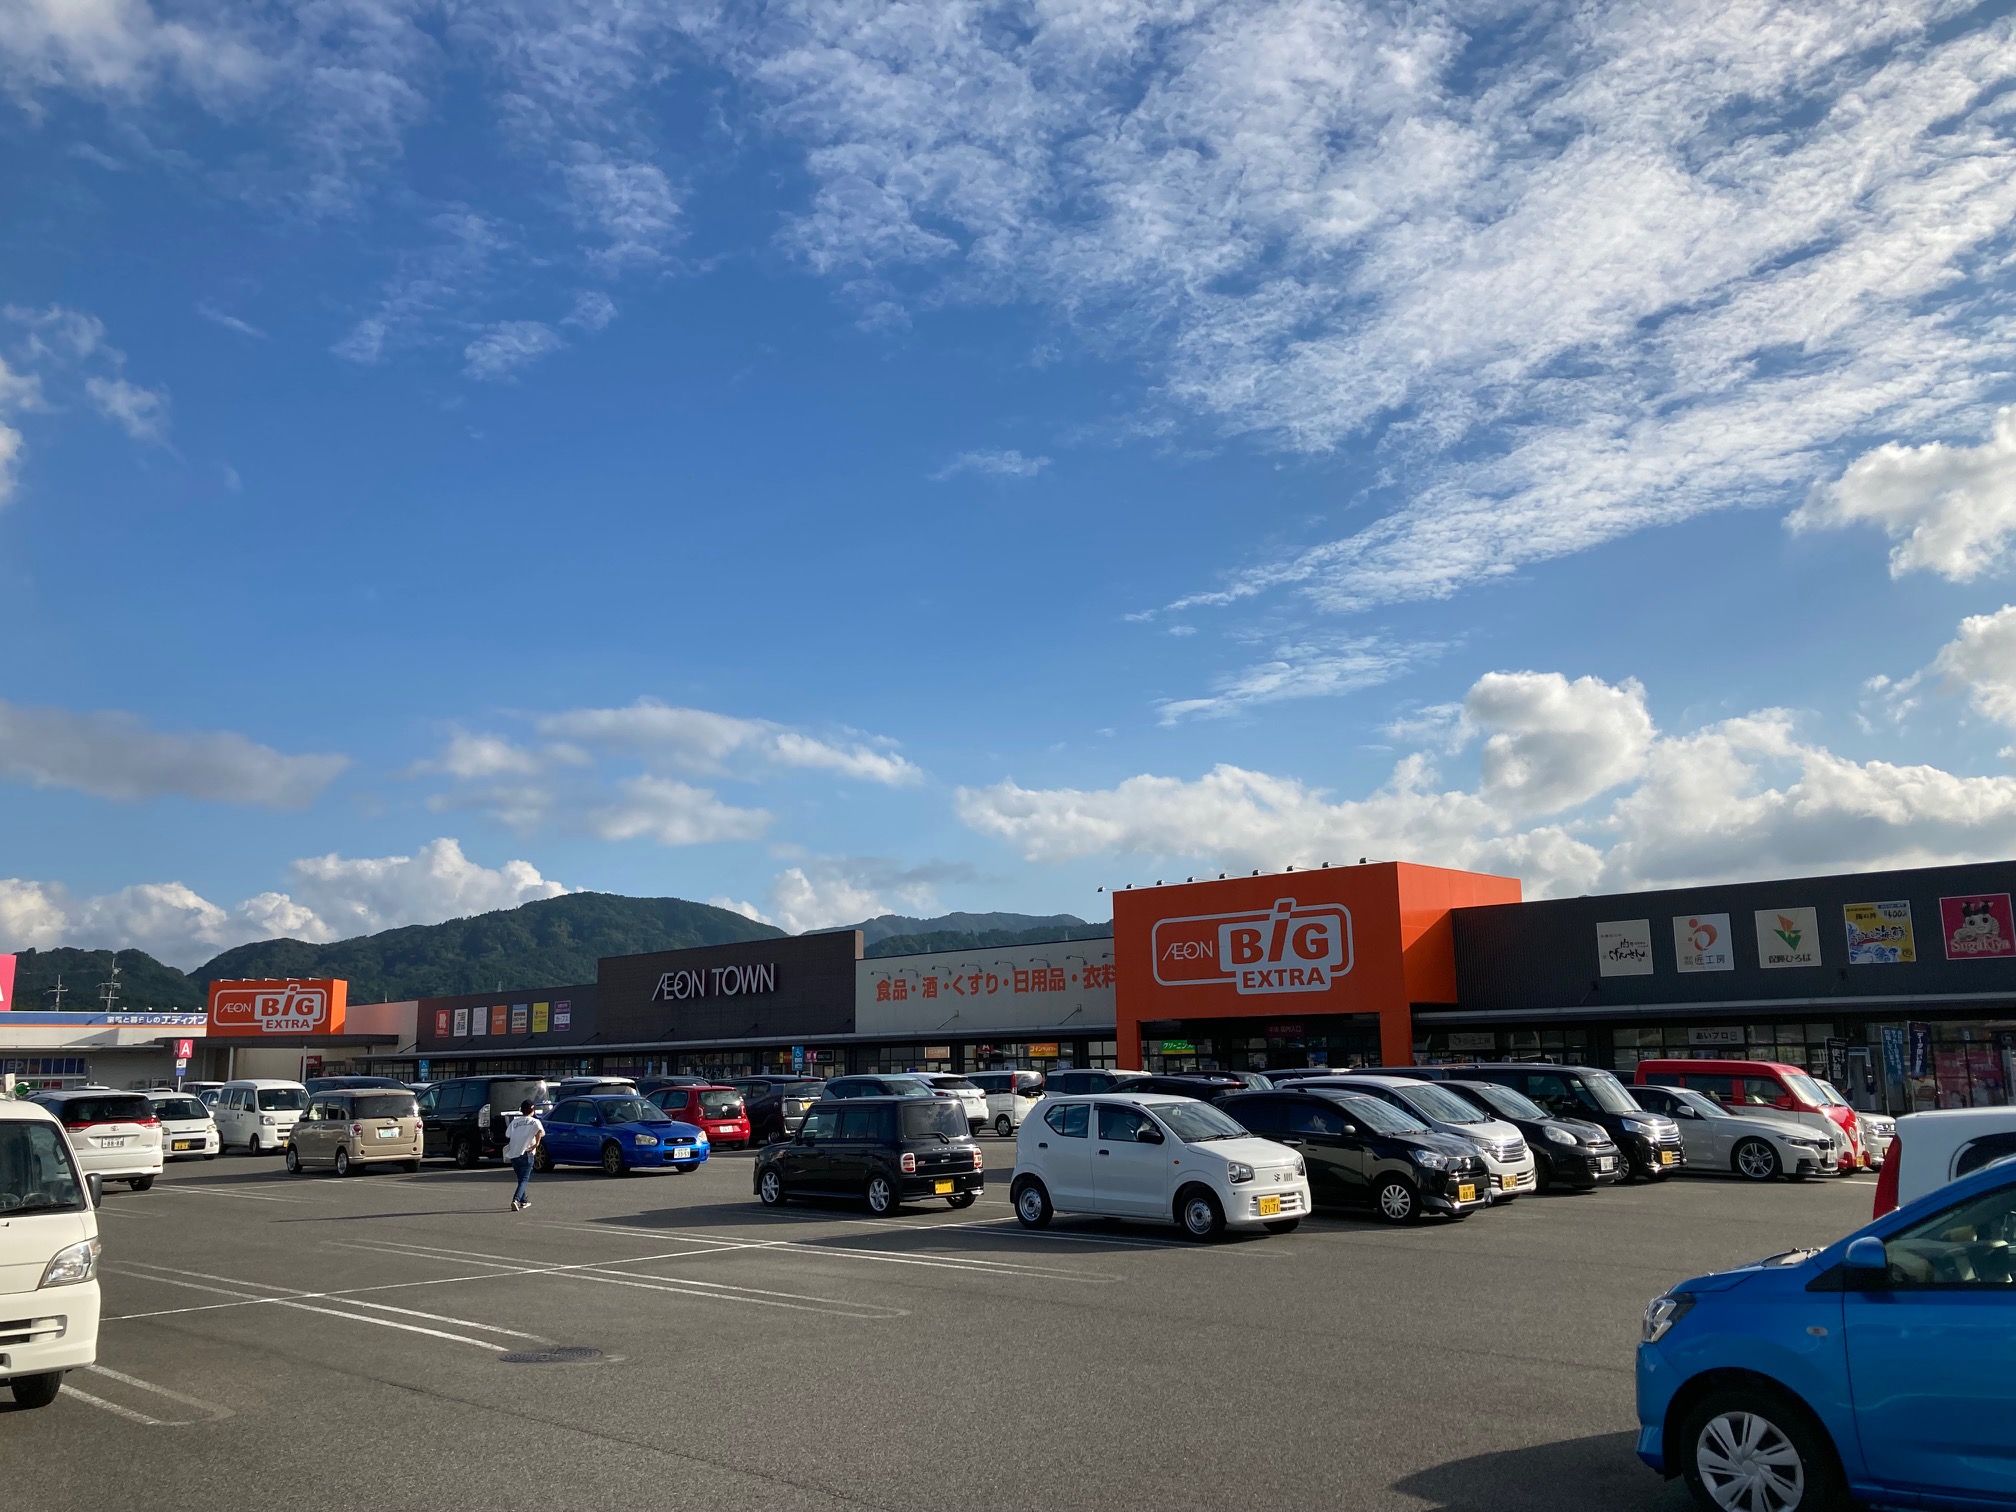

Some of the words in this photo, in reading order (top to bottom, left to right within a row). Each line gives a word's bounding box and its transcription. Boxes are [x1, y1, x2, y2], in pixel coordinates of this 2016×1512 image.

[1950, 937, 2011, 953] Sugakiya
[1695, 954, 1726, 966] 匠工房
[1768, 953, 1812, 964] 保険ひろば
[711, 963, 775, 996] TOWN
[1242, 967, 1326, 989] EXTRA
[266, 1018, 310, 1029] EXTRA
[181, 1043, 191, 1056] A
